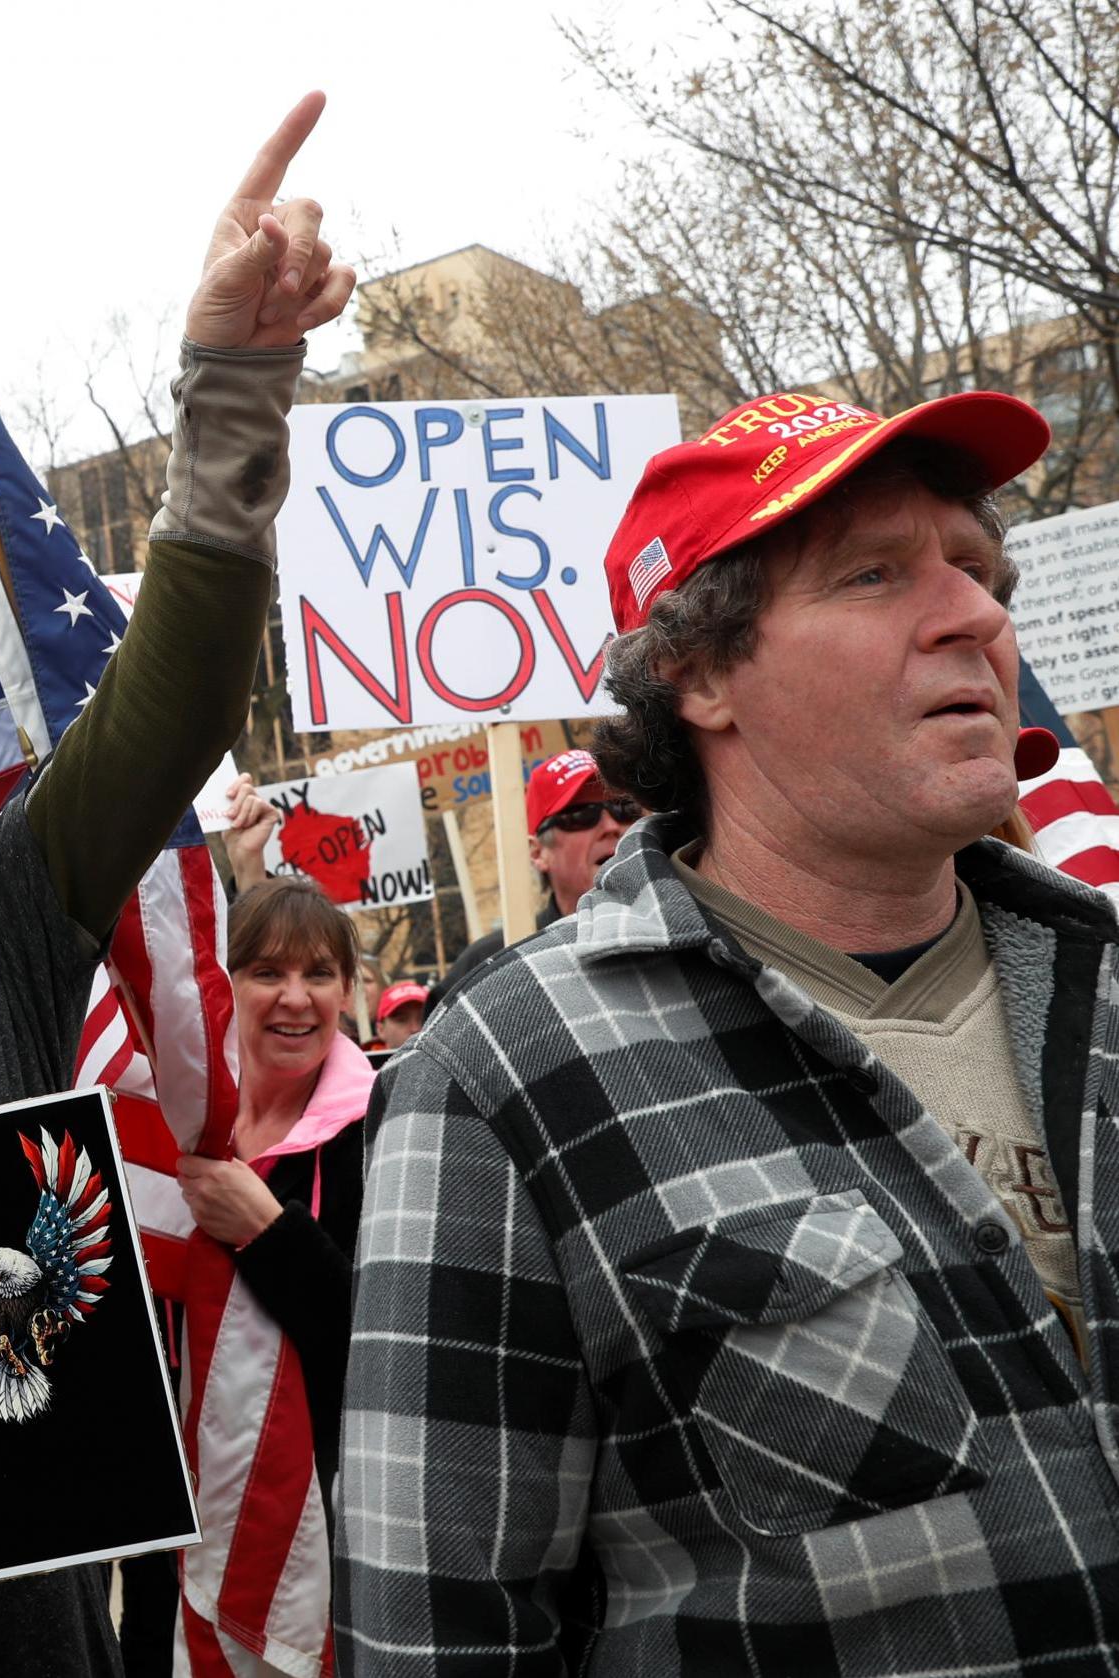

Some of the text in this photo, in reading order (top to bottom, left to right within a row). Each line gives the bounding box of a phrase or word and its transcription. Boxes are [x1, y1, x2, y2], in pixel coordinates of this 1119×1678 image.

[699, 393, 835, 447] TRU
[768, 403, 867, 438] 2020
[326, 403, 611, 488] OPEN
[752, 416, 875, 484] KEEP AMERICA
[316, 484, 578, 590] WIS.
[1034, 526, 1071, 545] shall
[1075, 519, 1119, 537] make
[1038, 553, 1057, 565] an
[1047, 611, 1063, 625] of
[1067, 625, 1108, 641] right
[1062, 653, 1079, 663] to
[359, 859, 431, 906] NOW!
